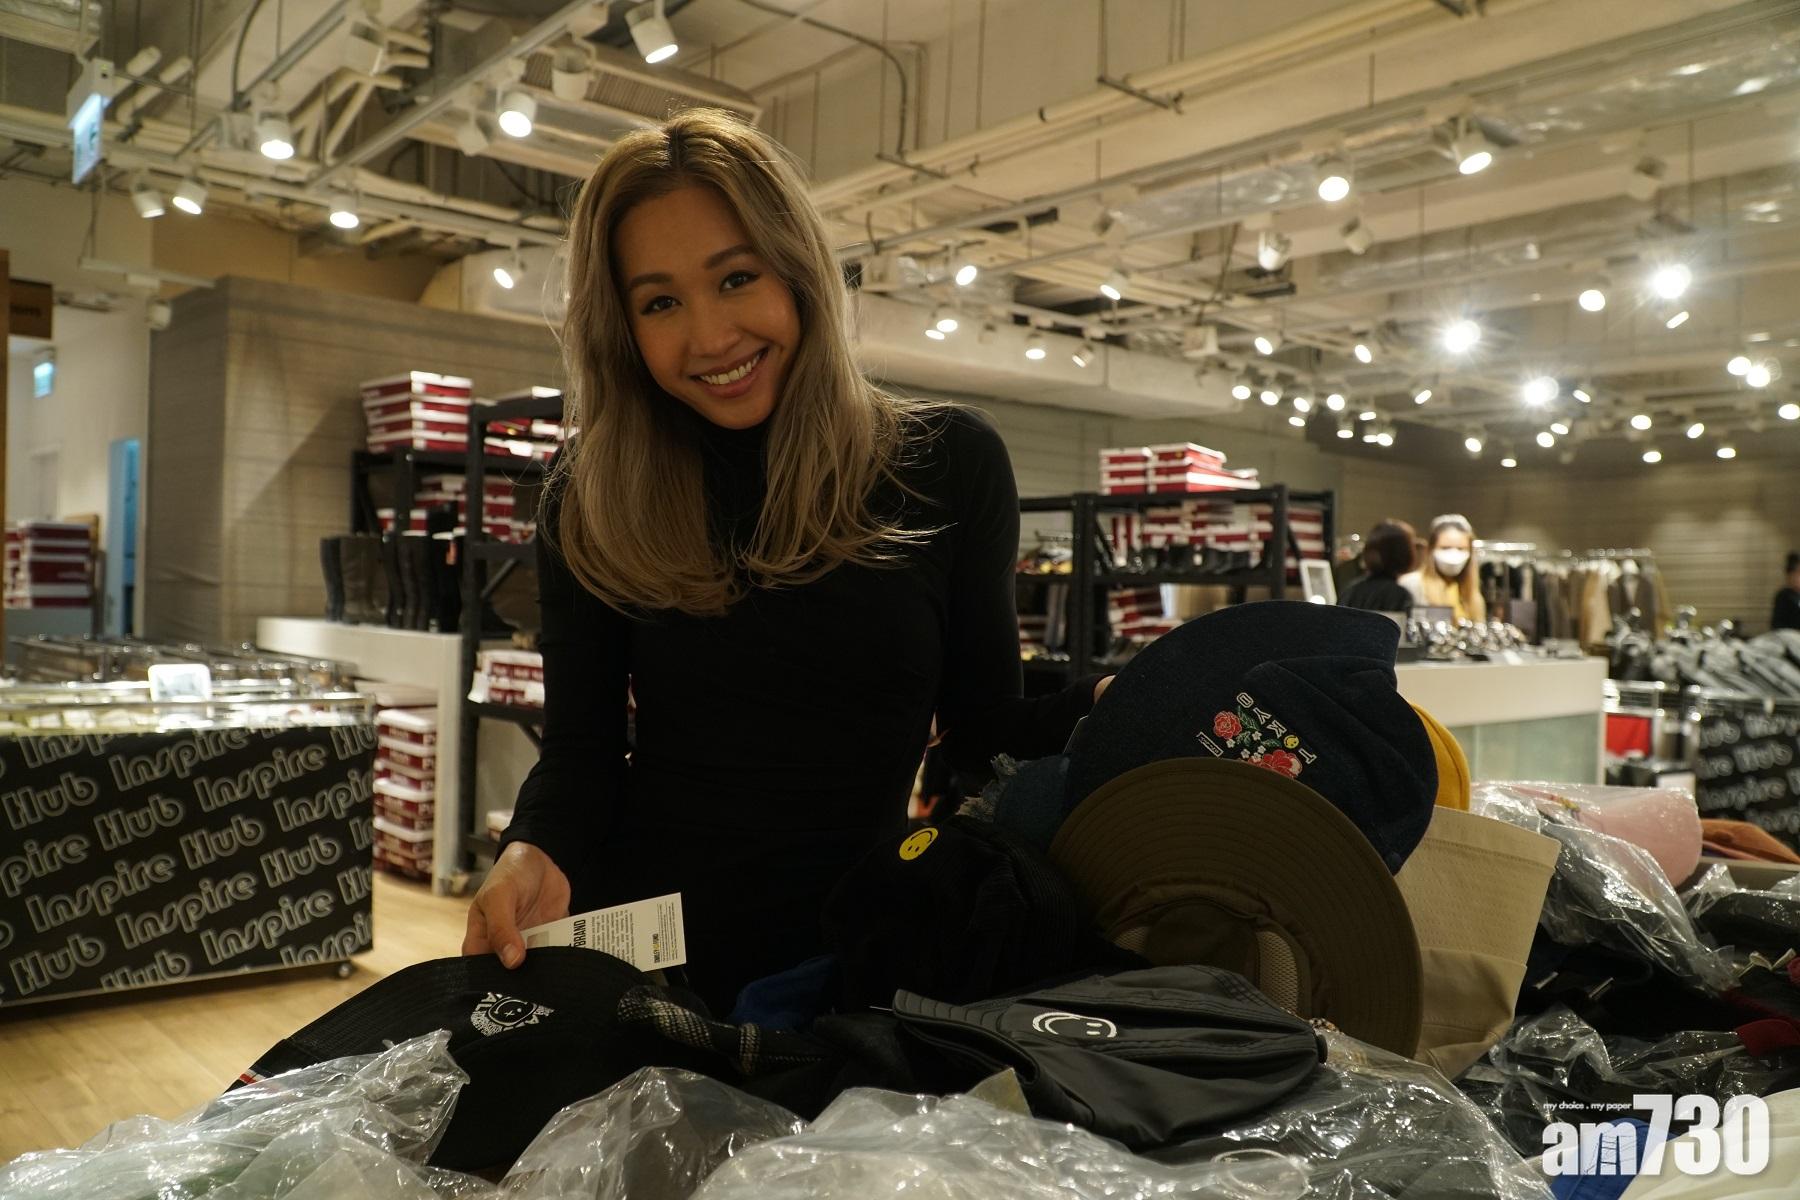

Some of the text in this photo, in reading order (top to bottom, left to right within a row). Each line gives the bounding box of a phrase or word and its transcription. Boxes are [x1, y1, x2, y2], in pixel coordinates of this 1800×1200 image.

[1, 730, 250, 830] Hub Inspire
[93, 793, 185, 851] Hub
[193, 744, 328, 813] Inspire
[25, 853, 177, 934] Inspire
[259, 833, 343, 888] Hub
[179, 814, 265, 870] Hub
[9, 933, 106, 996] Hub
[200, 889, 335, 966] Inspire
[114, 871, 258, 950] Inspire
